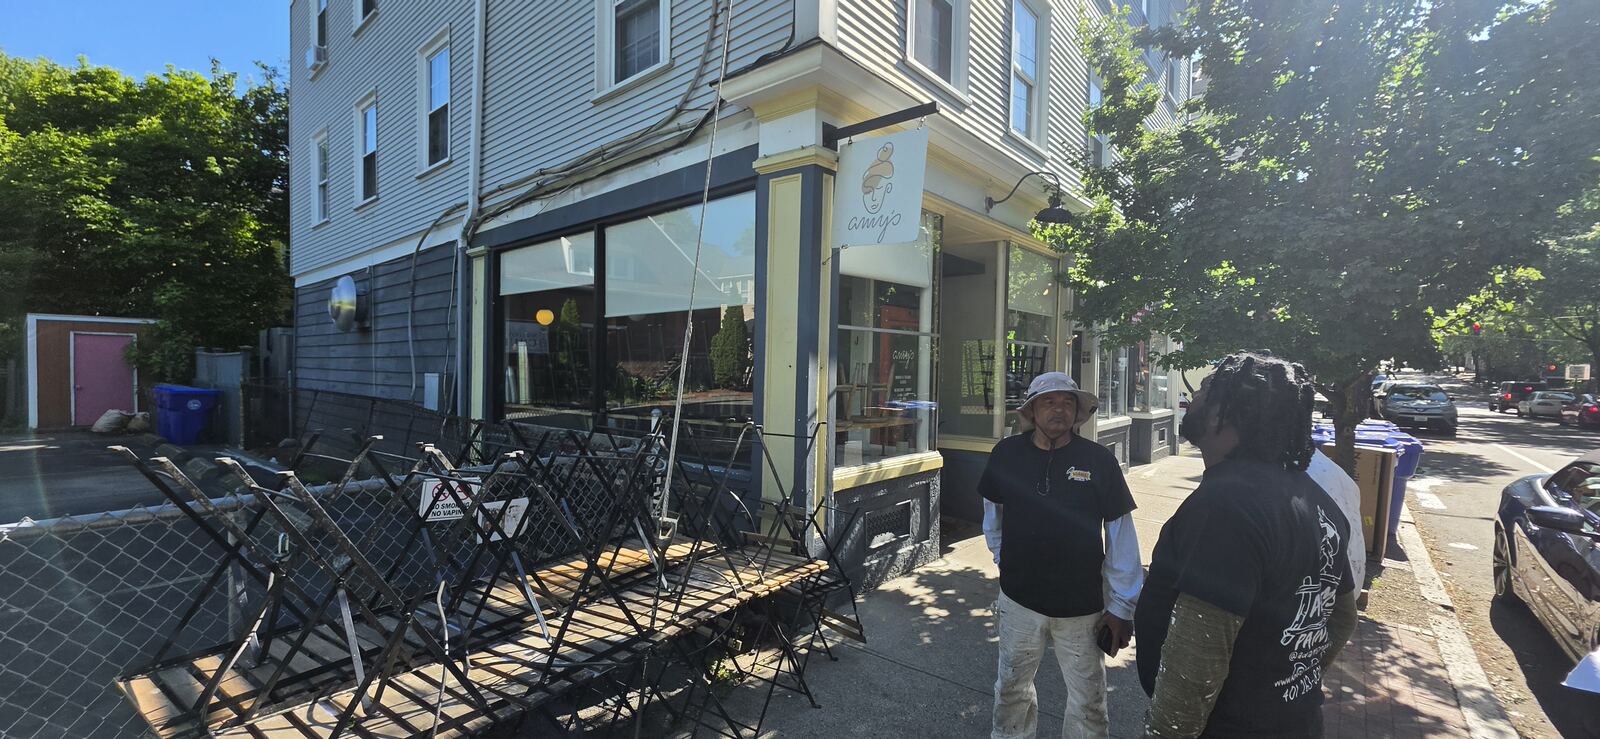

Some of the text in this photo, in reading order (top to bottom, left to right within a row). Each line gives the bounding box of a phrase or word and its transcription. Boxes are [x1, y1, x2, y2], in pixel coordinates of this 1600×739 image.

[848, 210, 901, 243] amy's
[441, 502, 469, 510] SMOG
[1294, 627, 1328, 650] PAIN
[1283, 684, 1298, 702] 401
